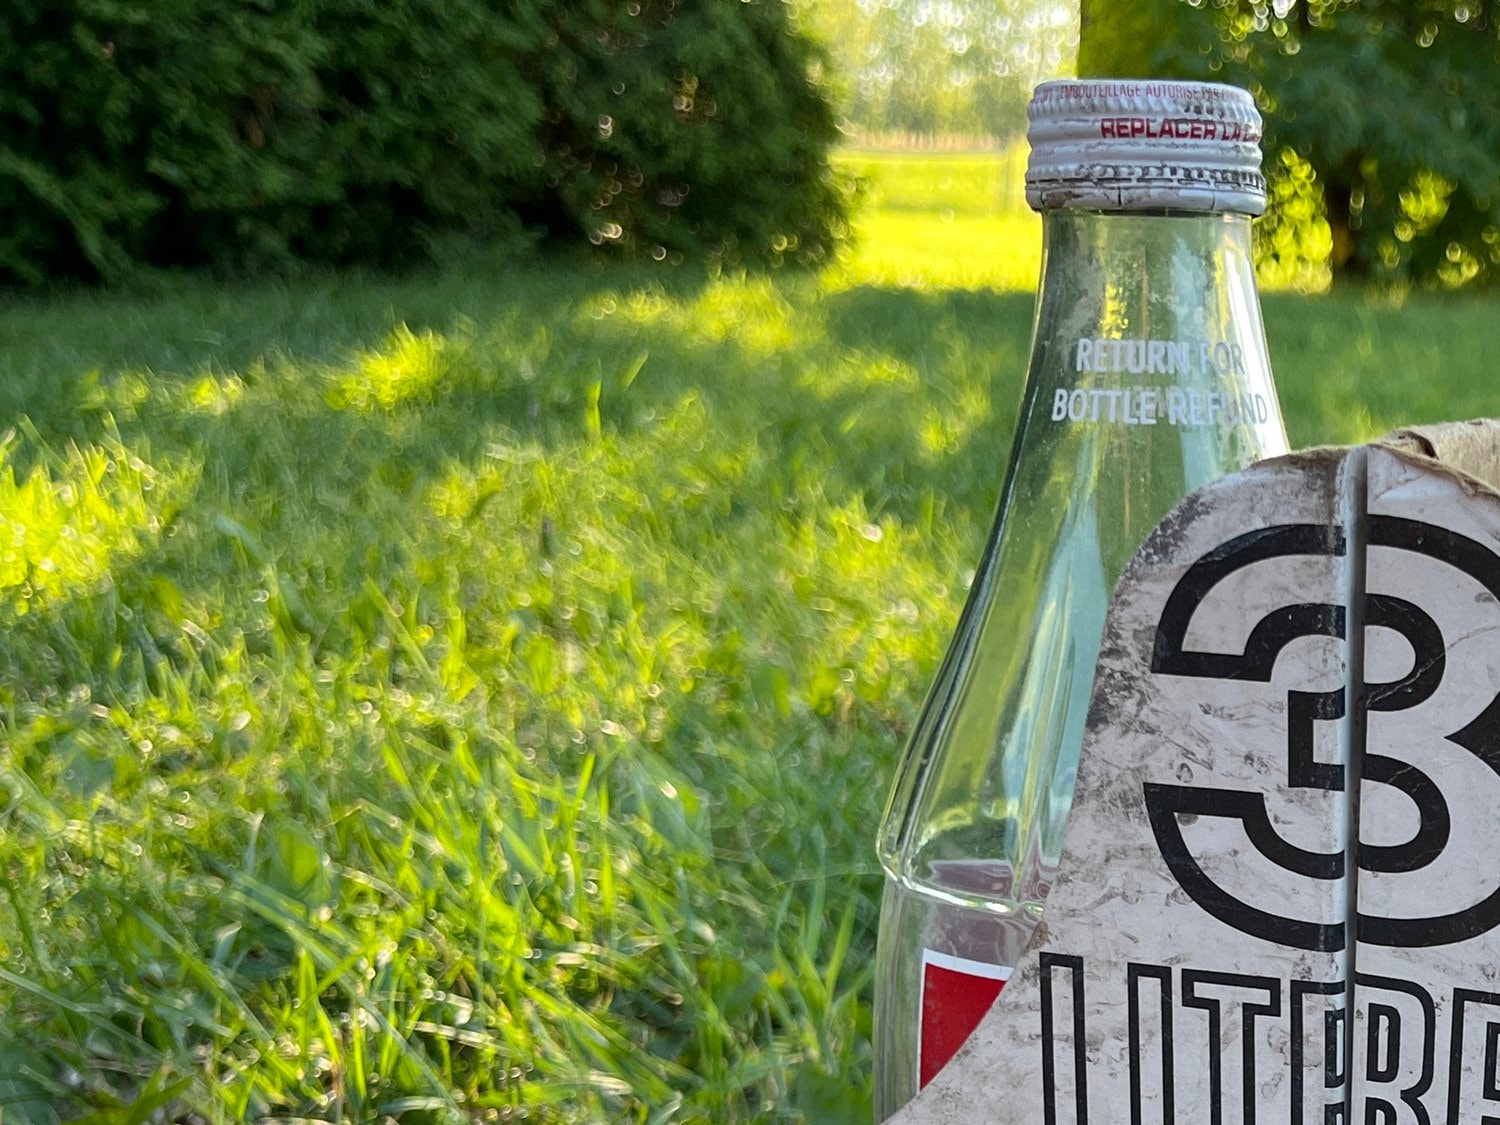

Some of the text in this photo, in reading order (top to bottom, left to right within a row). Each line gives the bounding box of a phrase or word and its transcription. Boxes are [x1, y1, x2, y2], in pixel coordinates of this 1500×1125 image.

[1100, 117, 1217, 139] REPLACER
[1075, 337, 1247, 376] RETURN FOR
[1051, 387, 1269, 426] BOTTLE REFUND
